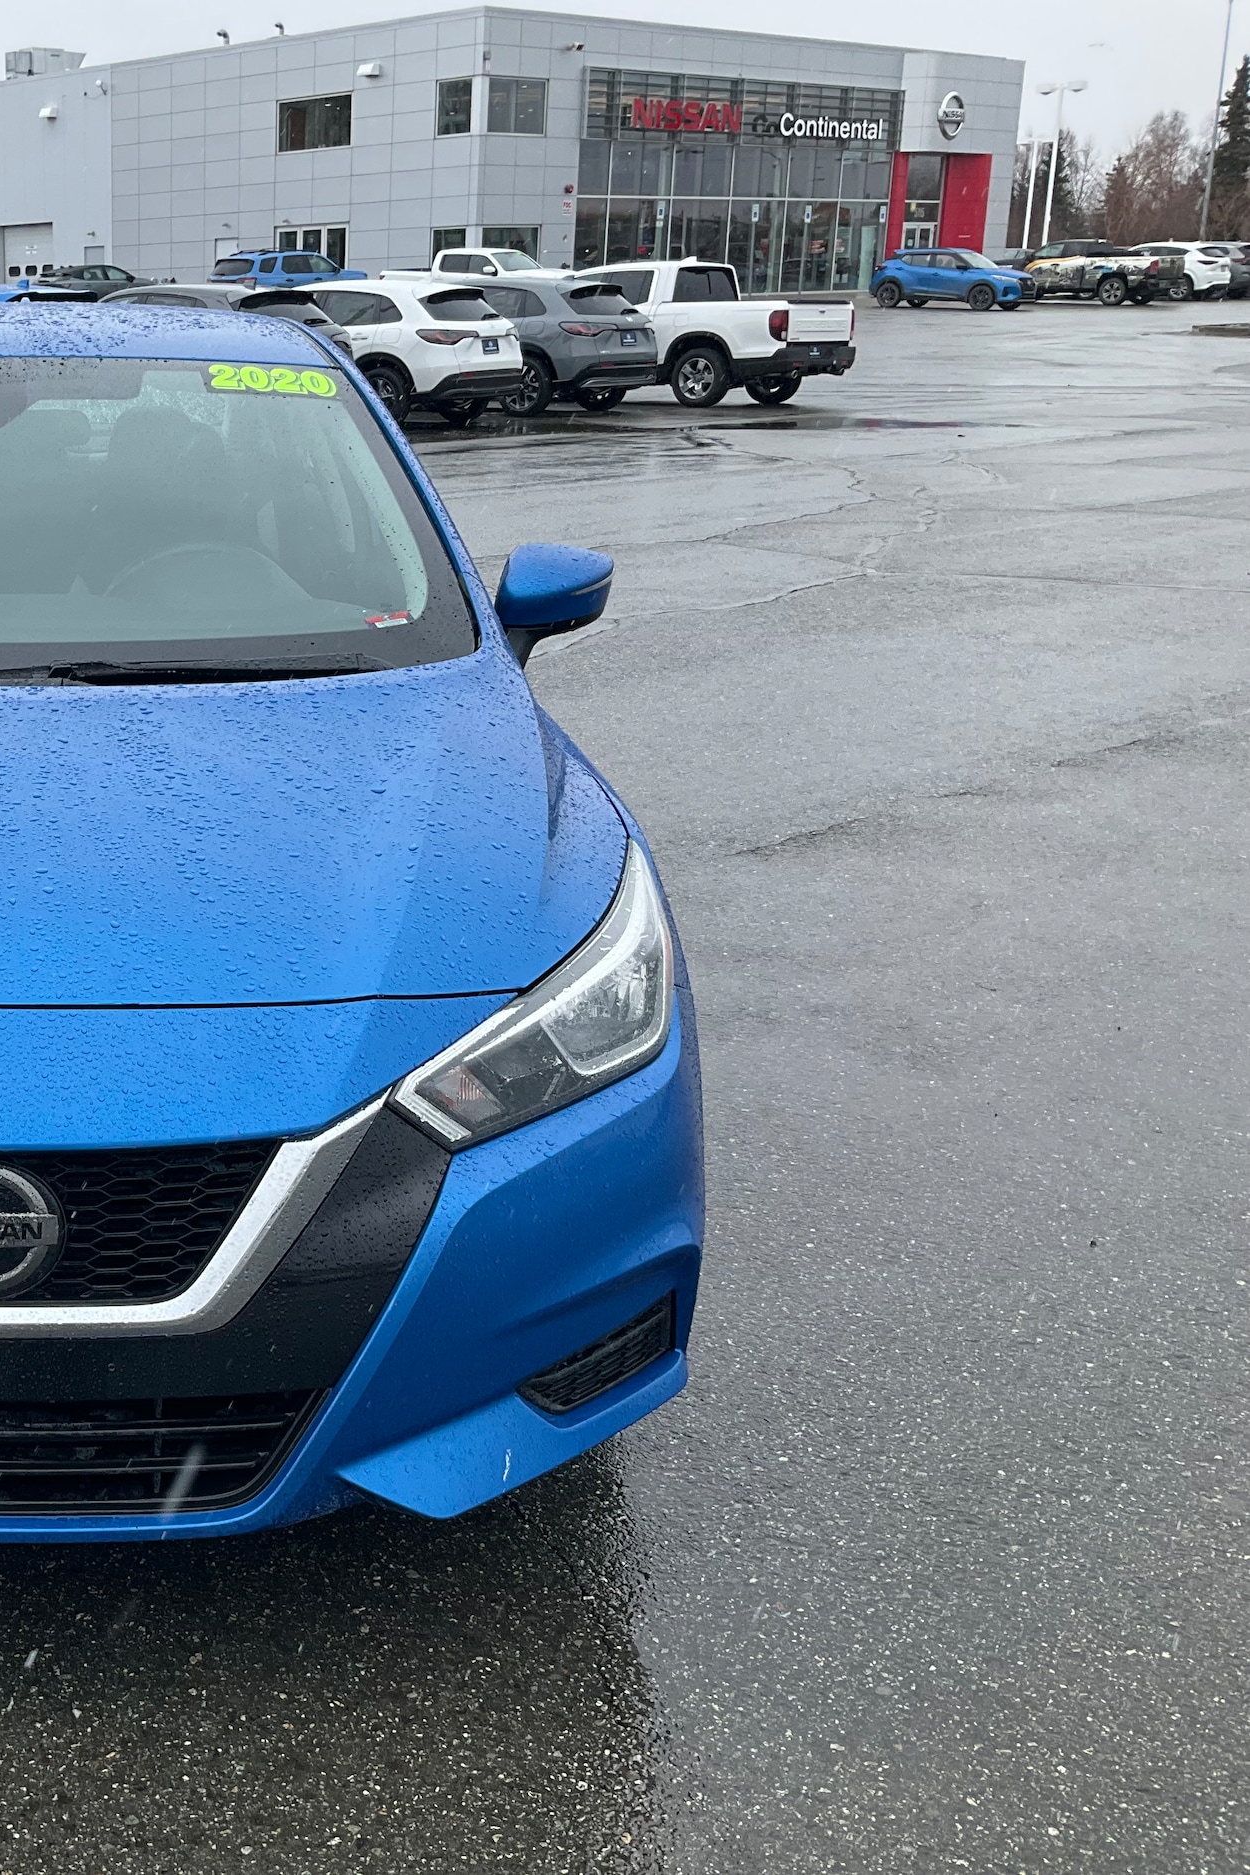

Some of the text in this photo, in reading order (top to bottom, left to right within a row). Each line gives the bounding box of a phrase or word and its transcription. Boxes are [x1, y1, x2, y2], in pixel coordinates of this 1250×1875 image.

[632, 97, 742, 133] NISSAN
[779, 112, 883, 140] Continental
[208, 364, 337, 397] 2020
